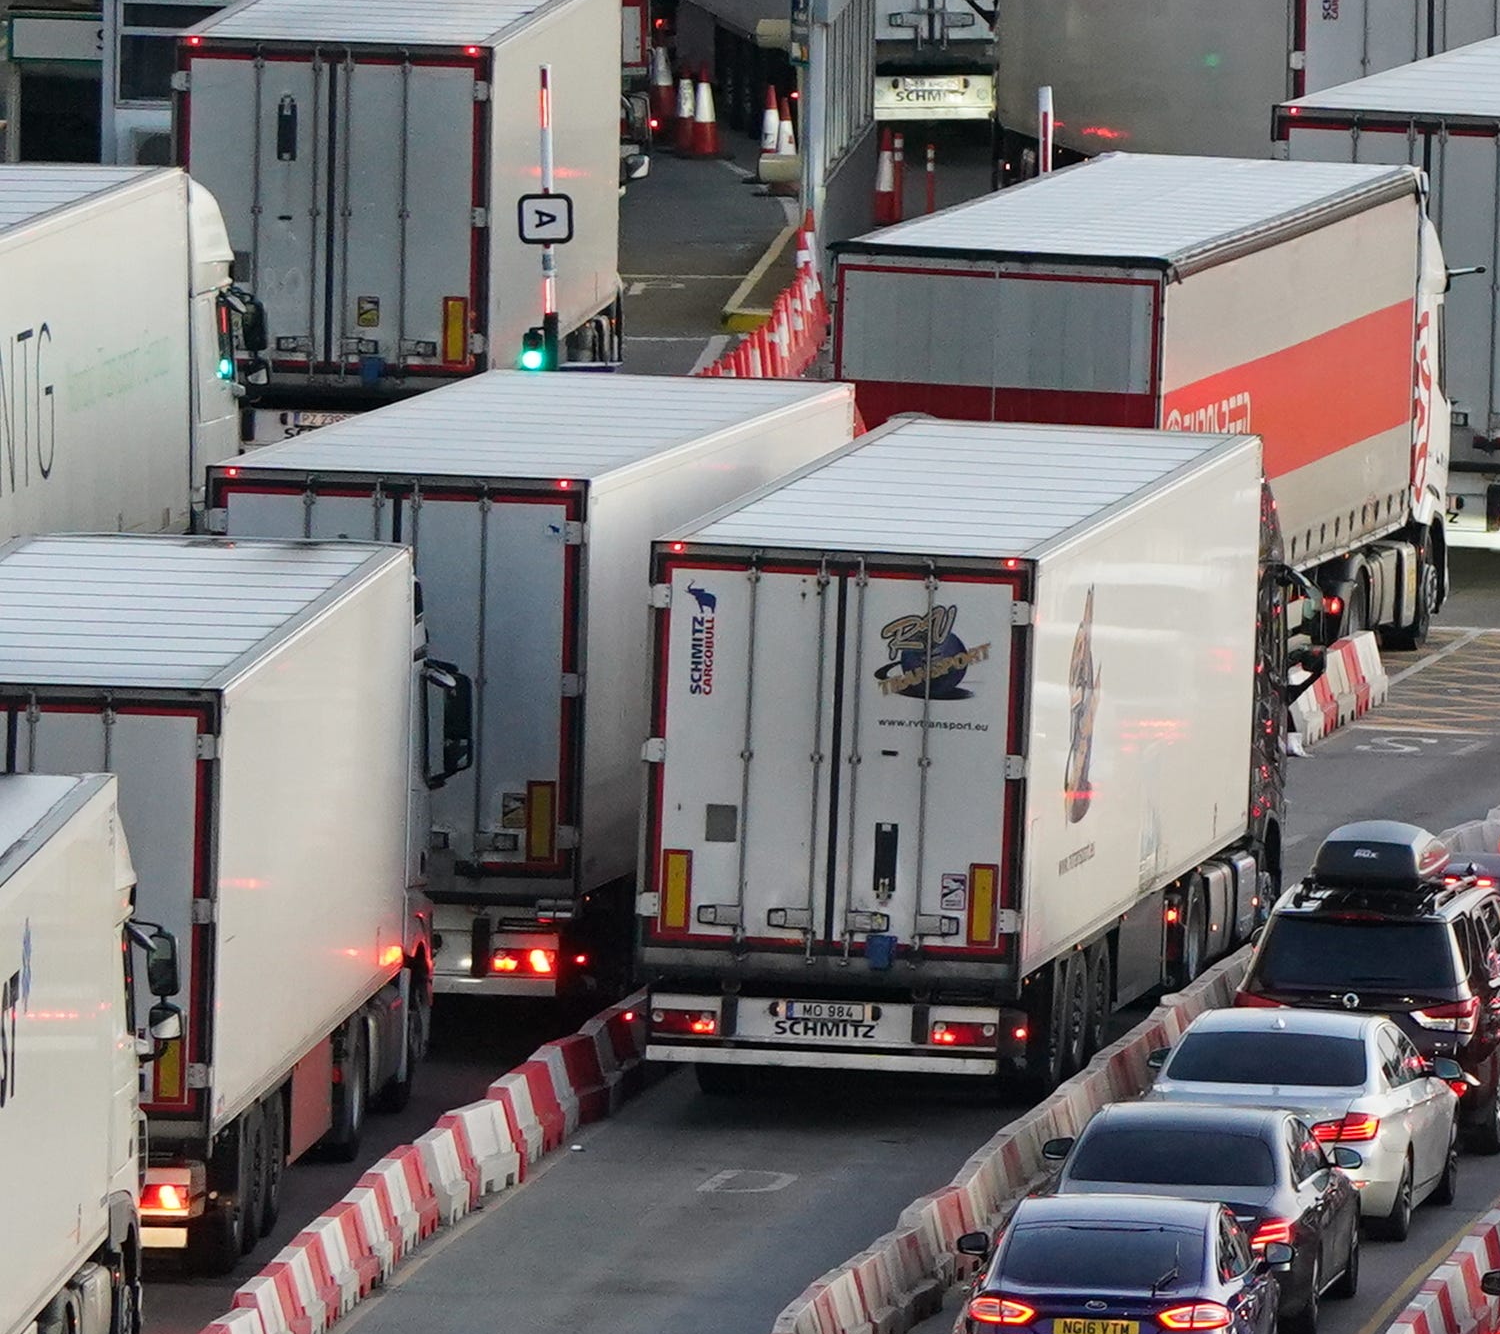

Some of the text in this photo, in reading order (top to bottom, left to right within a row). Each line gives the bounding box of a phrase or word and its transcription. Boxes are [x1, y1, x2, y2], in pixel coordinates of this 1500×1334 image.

[534, 209, 557, 229] A
[689, 616, 705, 696] SCHMITZ
[703, 616, 716, 696] CARGOBULL
[877, 641, 992, 697] TRANSPORT
[804, 1004, 854, 1017] MO 984
[774, 1019, 875, 1038] SCHMITZ
[1064, 1321, 1096, 1334] NG16
